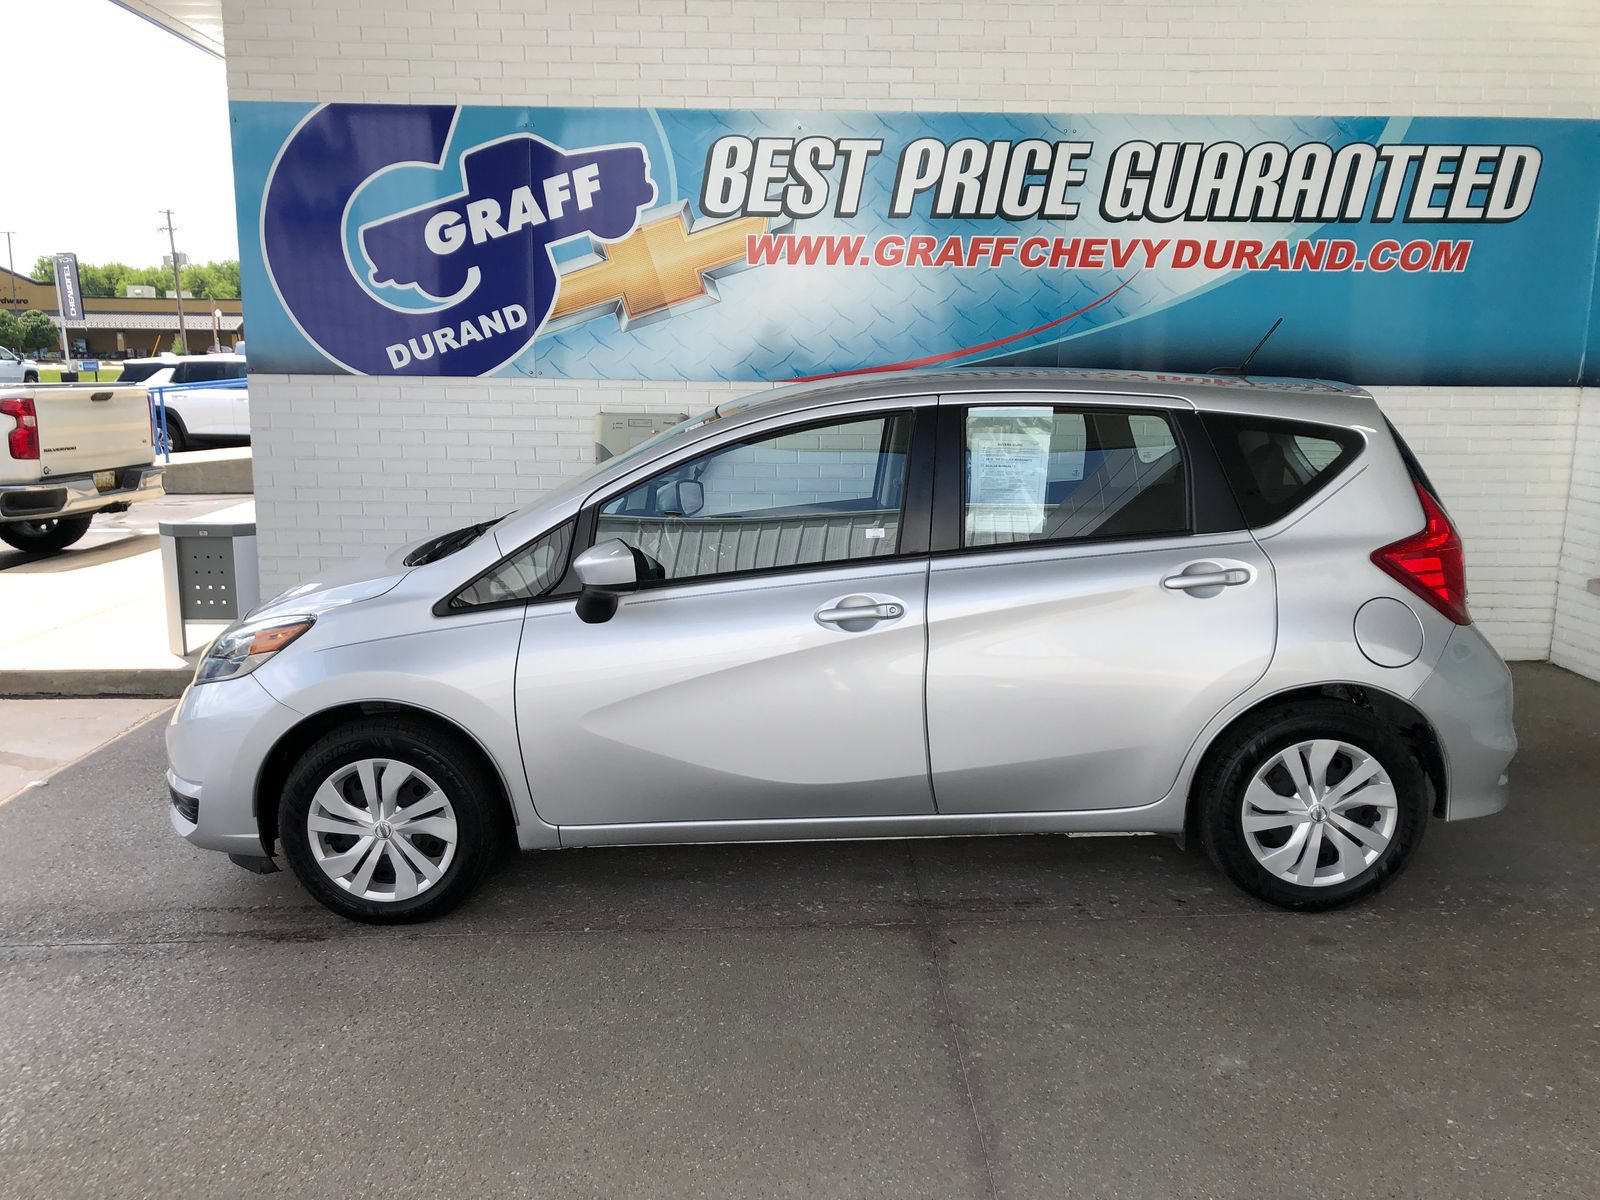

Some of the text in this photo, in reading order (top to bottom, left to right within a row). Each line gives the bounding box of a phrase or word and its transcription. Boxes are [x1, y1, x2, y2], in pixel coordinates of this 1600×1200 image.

[424, 163, 601, 255] GRAFF
[701, 135, 1543, 224] BEST PRICE GUARANTEED
[746, 235, 1472, 272] WWW.GRAFFCHEVYDURAND.COM
[385, 303, 528, 370] DURAND
